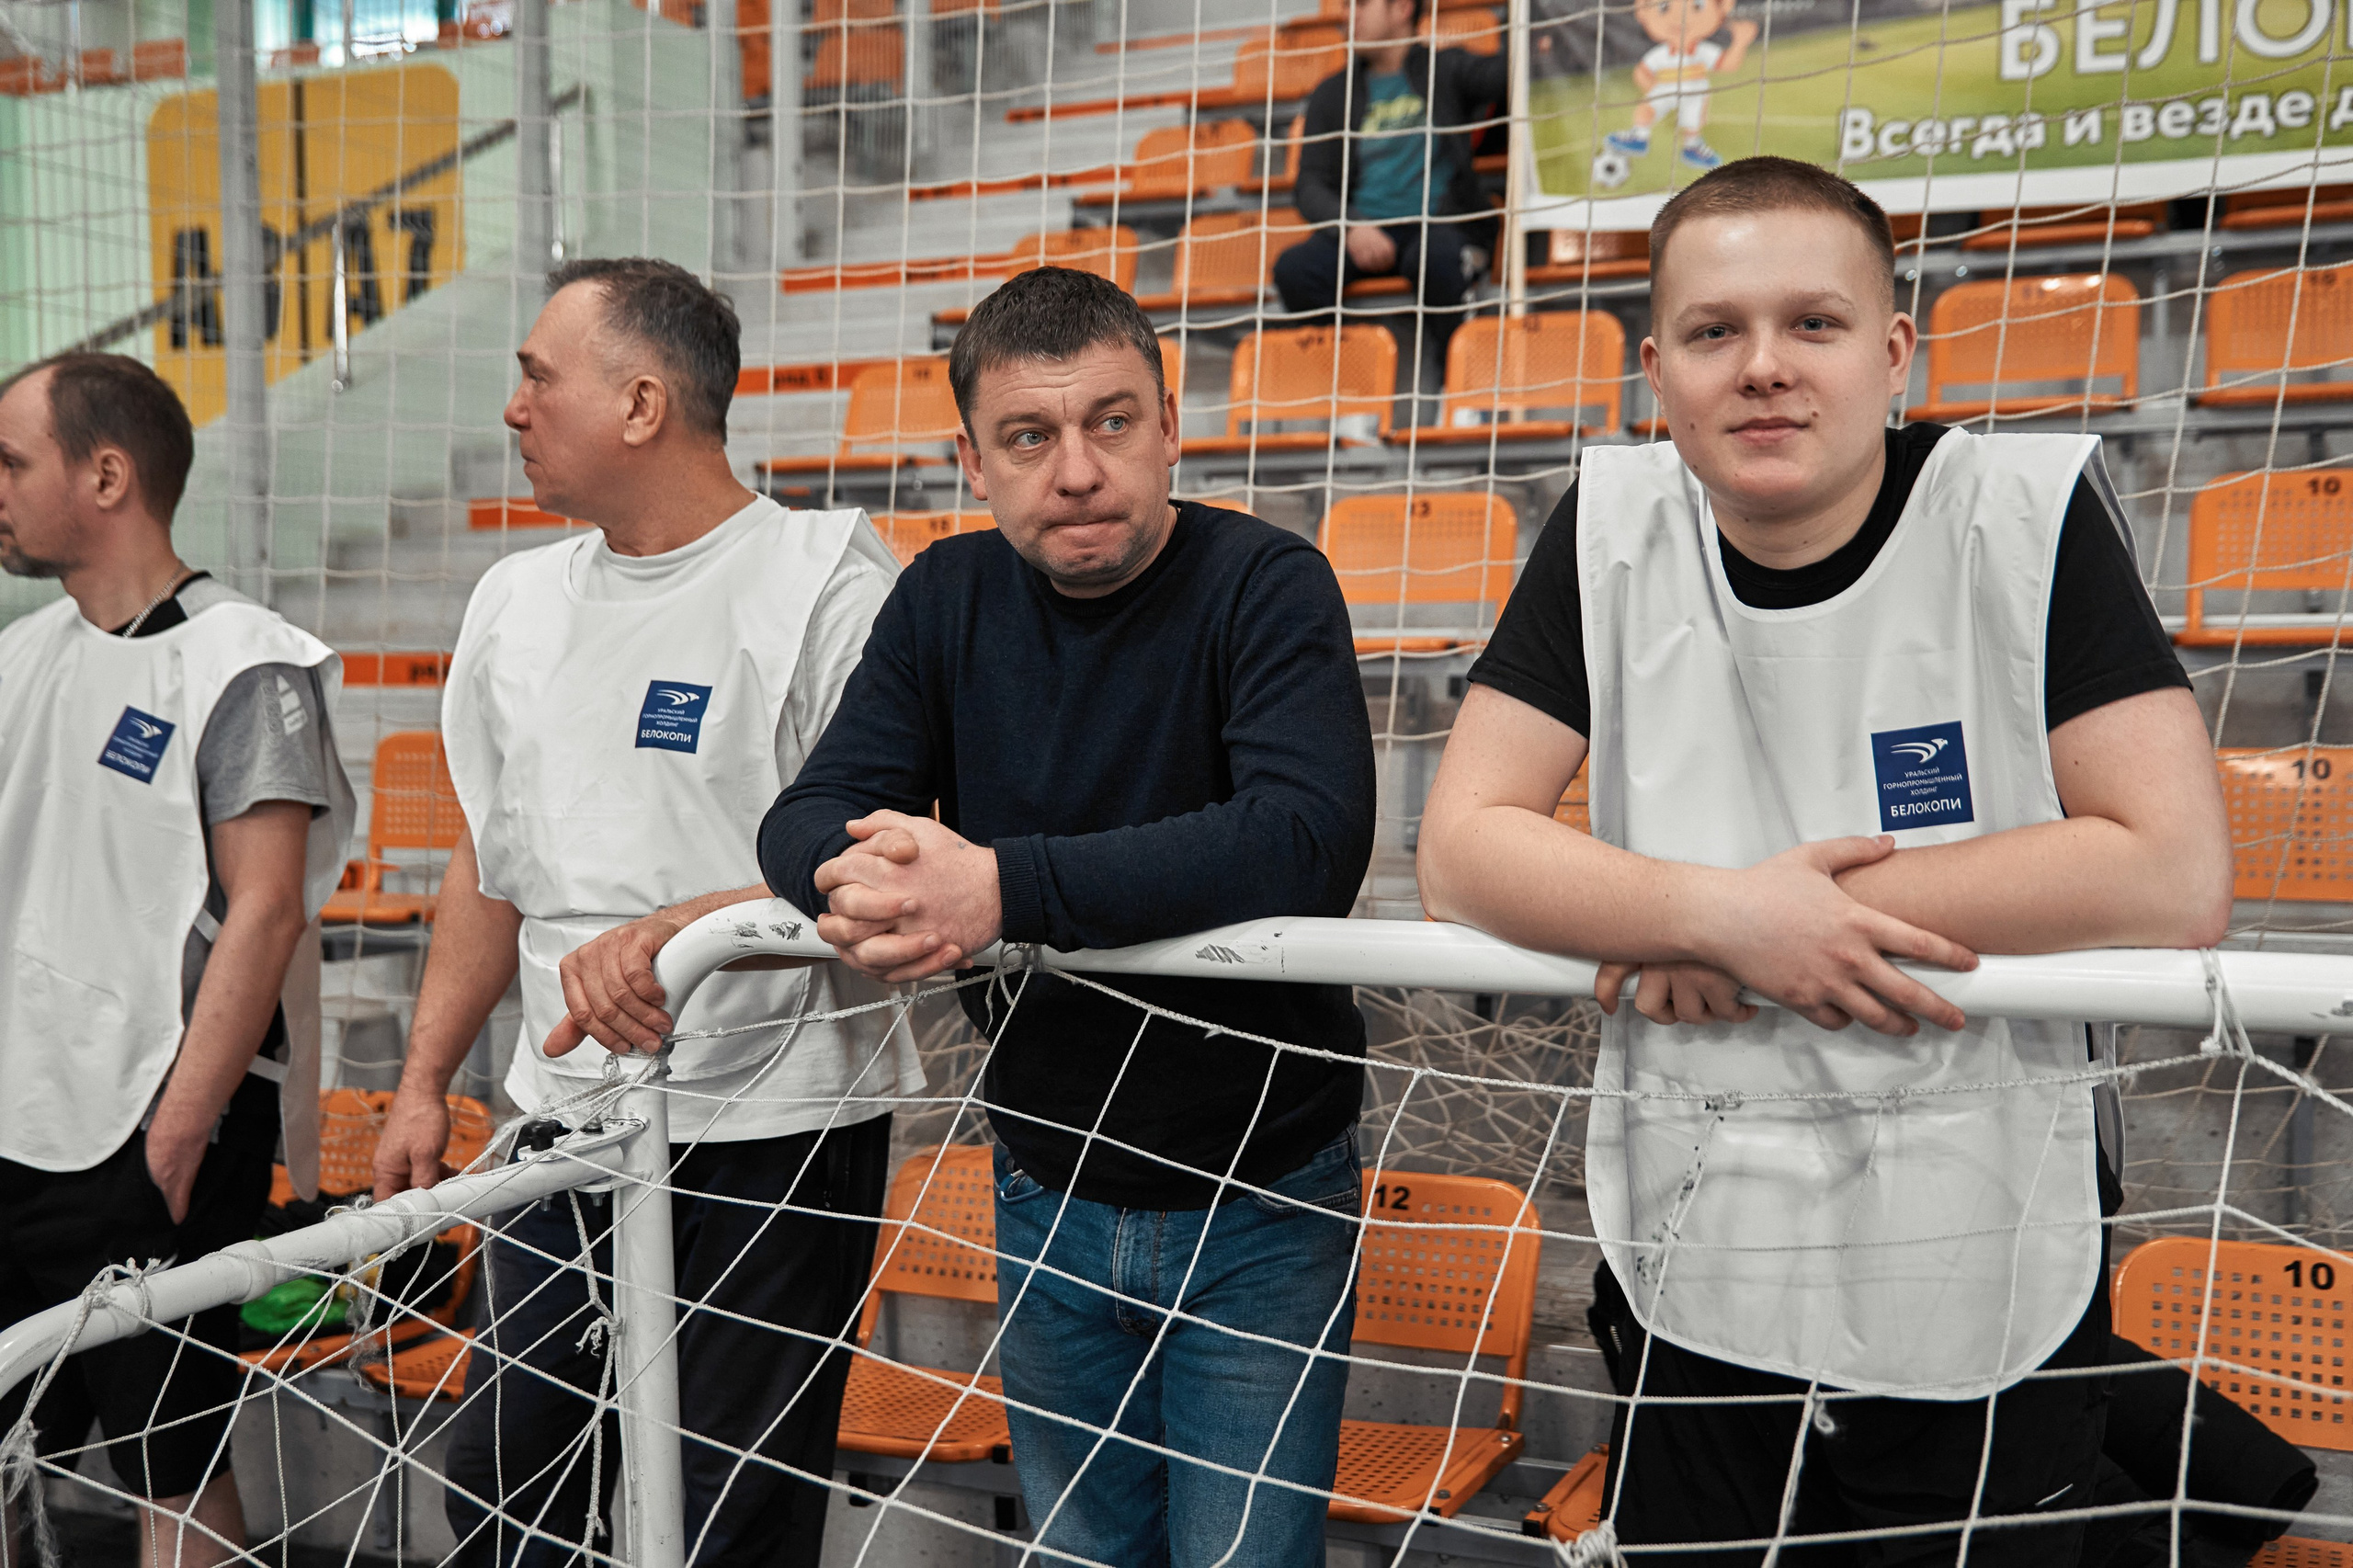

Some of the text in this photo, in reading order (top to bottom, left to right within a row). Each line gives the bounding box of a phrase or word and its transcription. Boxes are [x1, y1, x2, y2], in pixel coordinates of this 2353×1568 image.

[2001, 0, 2353, 80] БЕЛО
[1839, 107, 2047, 160] Всегда
[2063, 108, 2104, 146] и
[2122, 90, 2314, 142] везде
[2306, 476, 2341, 496] 10
[641, 729, 692, 743] БЕЛОКОПИ
[1904, 767, 1940, 778] УРАЛЬСКИЙ
[2291, 758, 2332, 780] 10
[1882, 773, 1963, 790] ГОРНОПРОМЫШЛЕННЫЙ
[1910, 786, 1938, 796] ХОЛДИНГ
[1890, 797, 1962, 817] БЕЛОКОПИ
[1375, 1184, 1411, 1210] 12
[2283, 1260, 2335, 1290] 10
